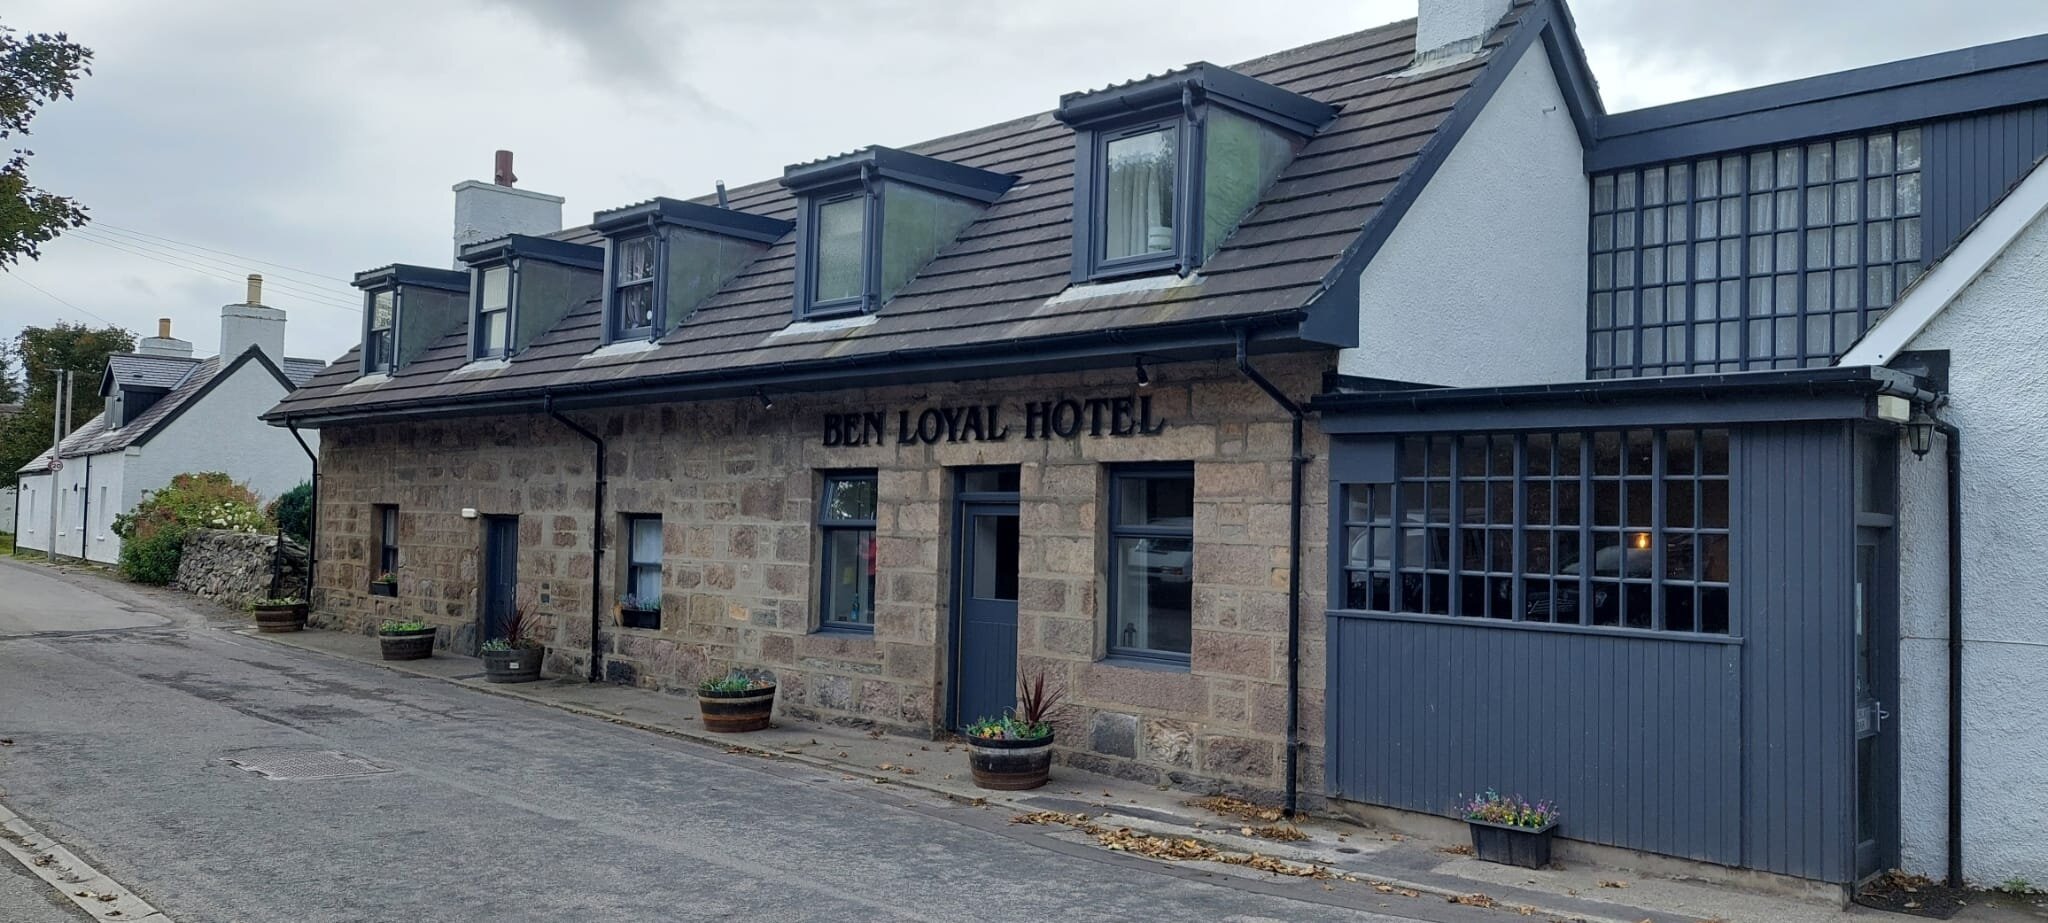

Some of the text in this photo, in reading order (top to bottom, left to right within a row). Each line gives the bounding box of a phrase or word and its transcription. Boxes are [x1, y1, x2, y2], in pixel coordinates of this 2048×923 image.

[823, 395, 1165, 447] BEN LOYAL HOTEL
